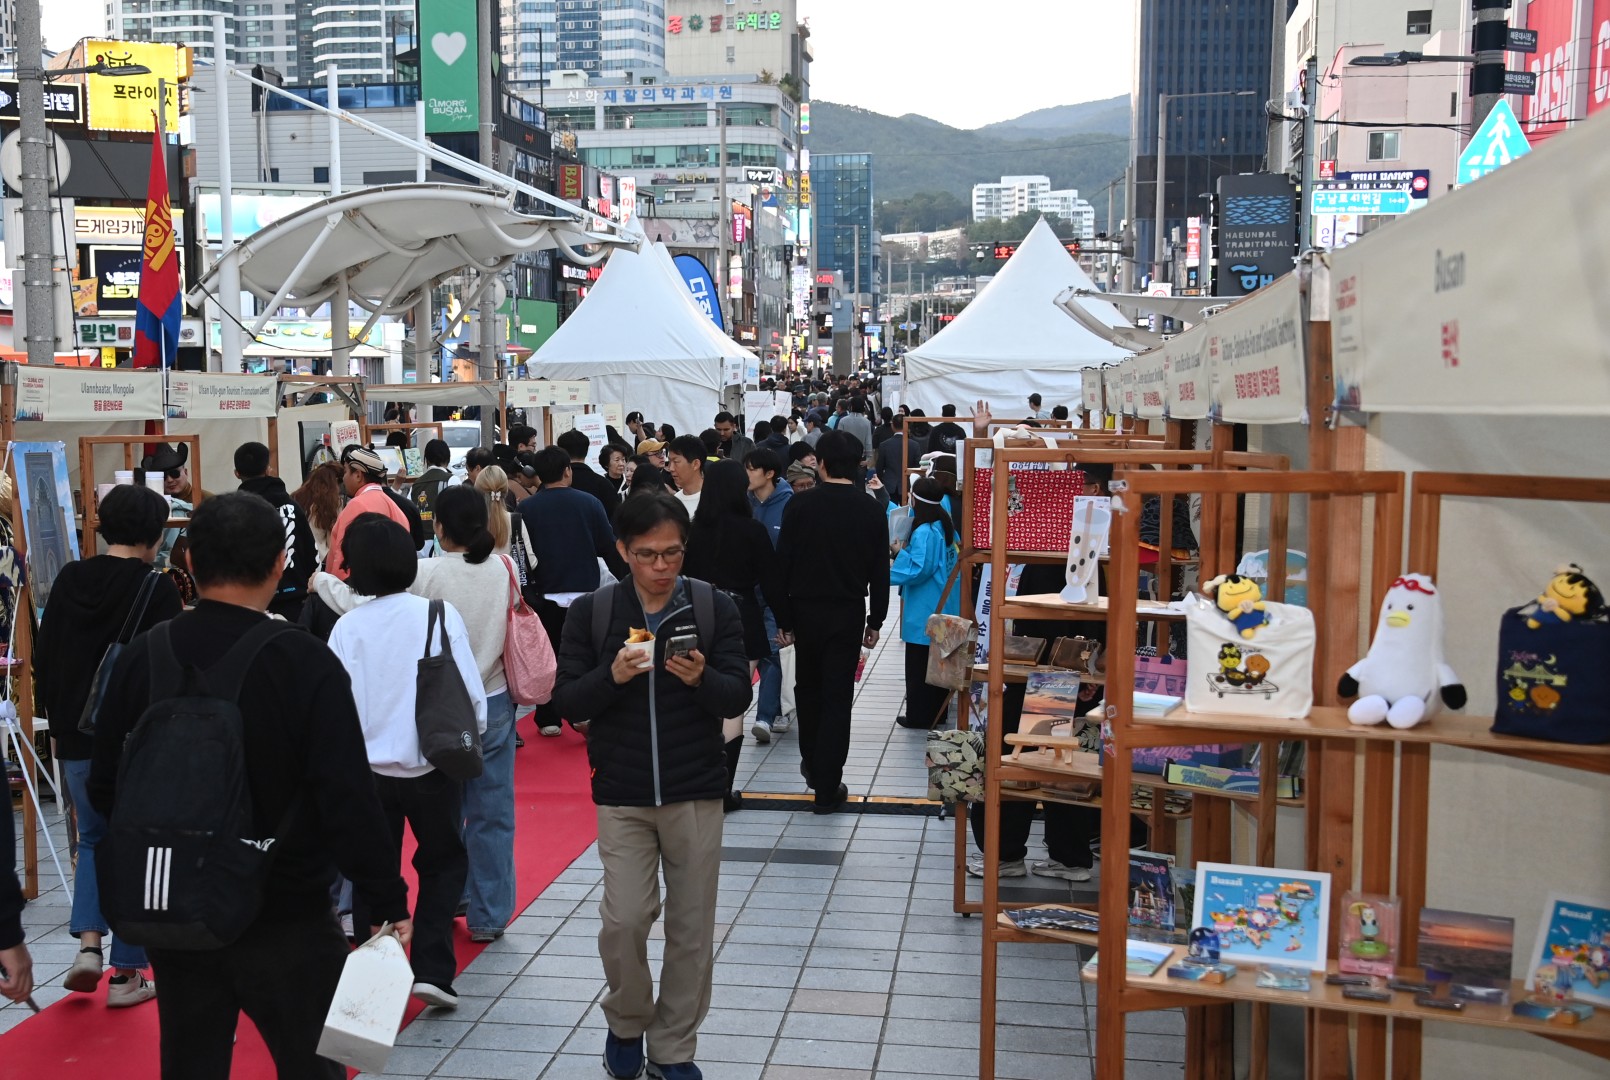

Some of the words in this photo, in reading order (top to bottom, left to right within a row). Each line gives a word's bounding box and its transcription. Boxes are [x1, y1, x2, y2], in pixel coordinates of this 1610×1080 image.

[433, 106, 467, 116] BUSAN
[565, 166, 577, 197] BAR
[1225, 231, 1277, 239] HAEUNDAE
[1321, 228, 1330, 244] CU
[1225, 240, 1290, 248] TRADITIONAL
[1225, 250, 1265, 258] MARKET
[80, 324, 116, 342] 밀면
[112, 384, 135, 397] Mongolia
[1211, 875, 1243, 887] Busan
[1559, 906, 1592, 921] Busan
